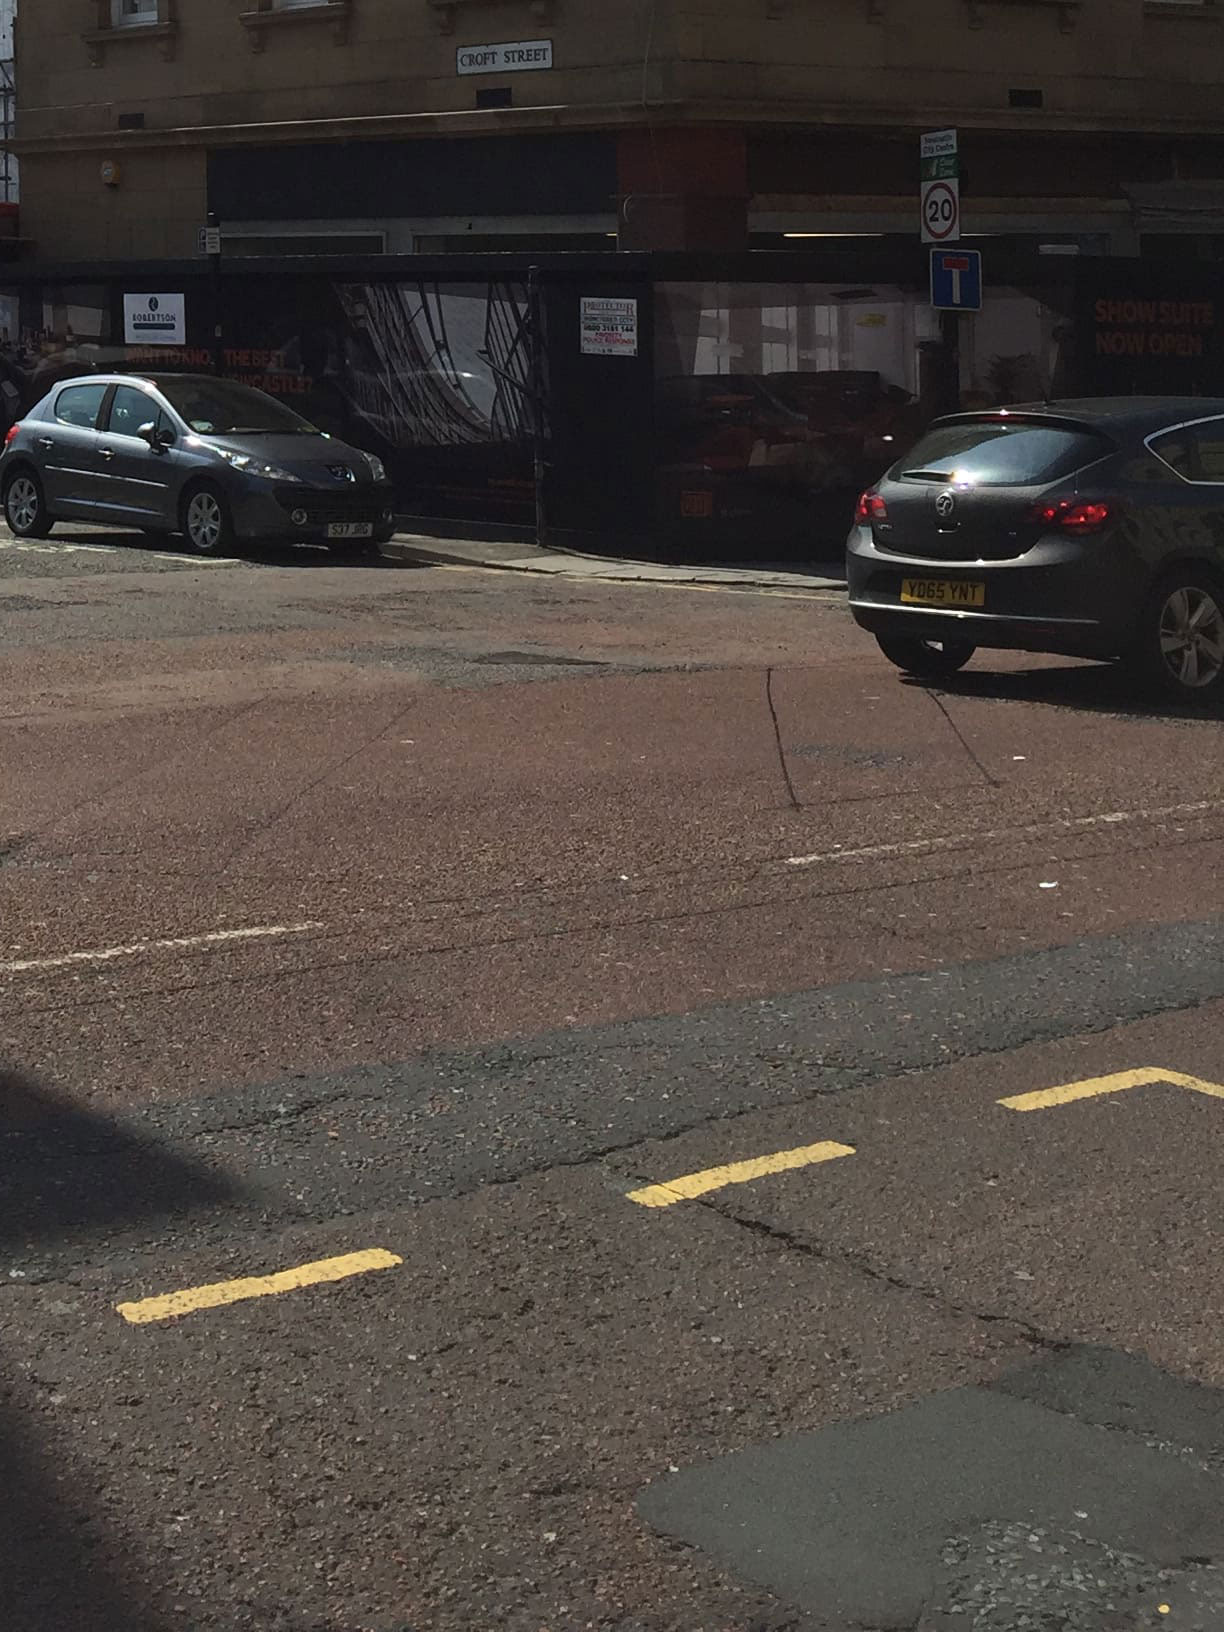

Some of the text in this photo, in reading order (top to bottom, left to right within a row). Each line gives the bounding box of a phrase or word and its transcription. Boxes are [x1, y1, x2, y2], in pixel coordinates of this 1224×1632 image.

[460, 48, 549, 67] CROFT STREET
[928, 198, 953, 222] 20
[132, 313, 176, 322] ROBERTSON
[1096, 298, 1214, 324] SHOW SUITE
[1096, 331, 1202, 357] NOW OPEN
[181, 347, 211, 365] KNO
[252, 349, 287, 368] BEST
[908, 581, 979, 601] YD65 YNT
